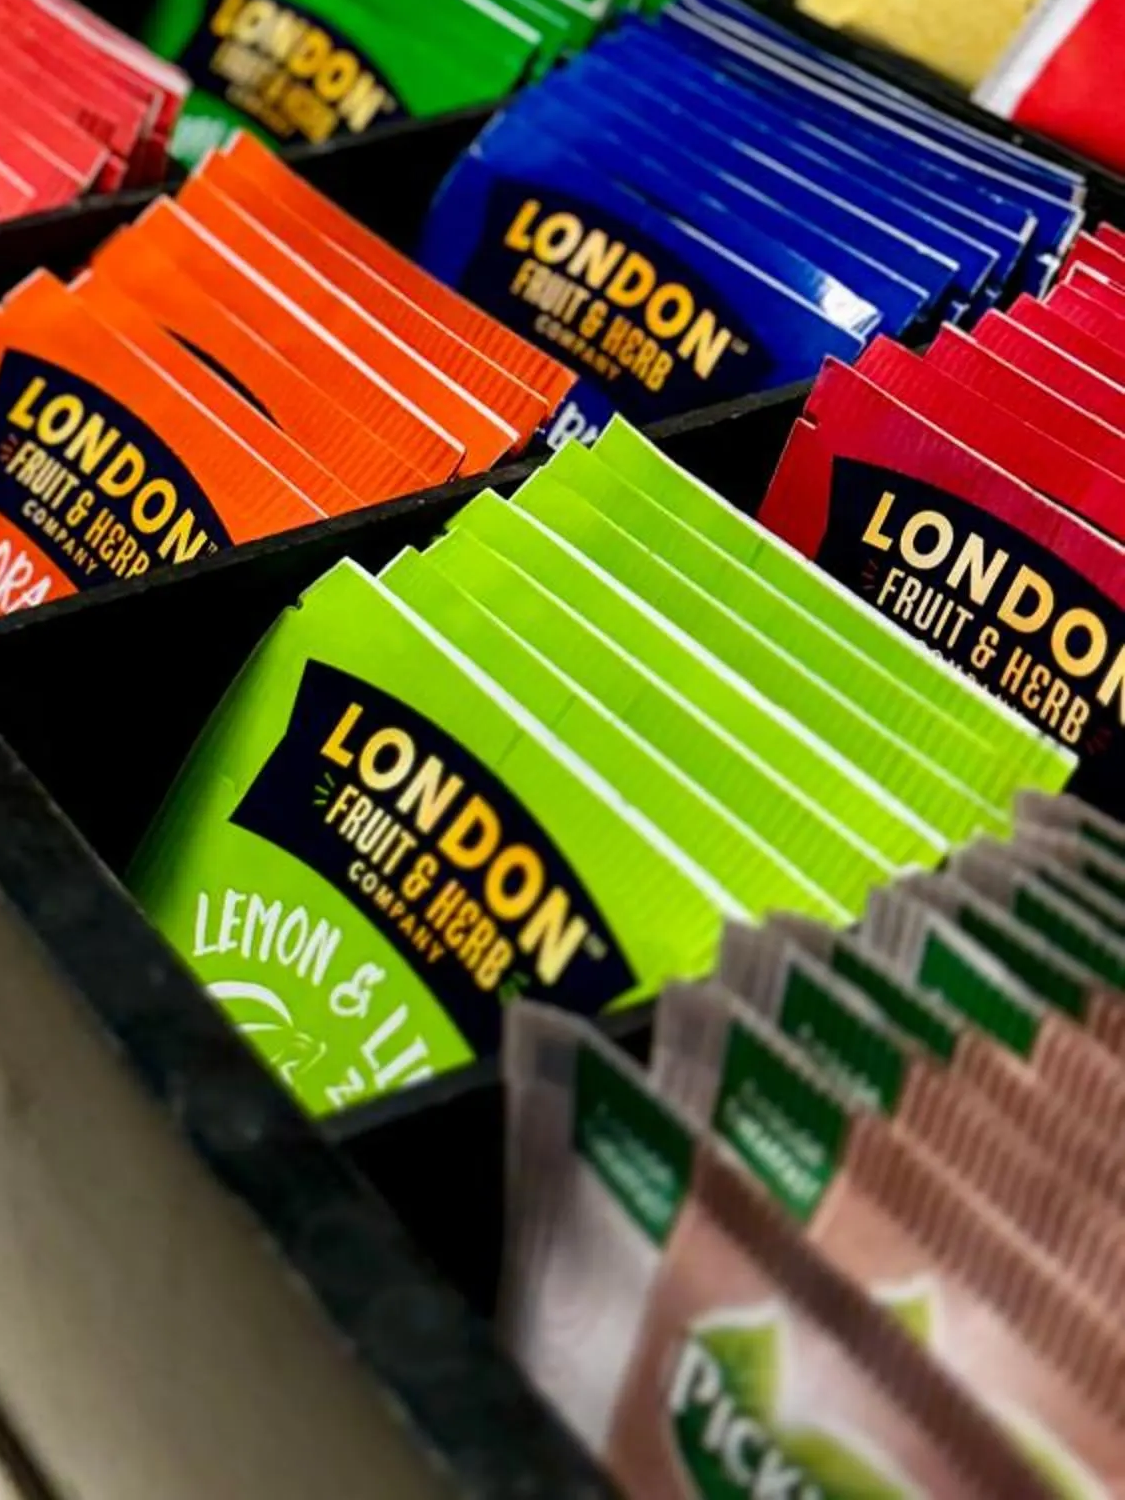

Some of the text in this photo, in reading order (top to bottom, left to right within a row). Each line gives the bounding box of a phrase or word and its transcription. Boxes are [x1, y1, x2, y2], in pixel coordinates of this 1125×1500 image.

[504, 198, 732, 380] LONDON
[509, 258, 674, 392] FRUIT & HERB
[5, 440, 82, 511] FRUIT
[65, 487, 96, 528] &
[7, 375, 208, 564] LONDON
[21, 499, 100, 577] COMPANY
[877, 566, 975, 649] FRUIT
[969, 625, 1001, 671] &
[998, 646, 1091, 745] HERB
[320, 701, 587, 987] LONDON
[325, 784, 515, 992] FRUIT & HERB
[347, 861, 448, 966] COMPANY
[192, 888, 342, 987] LEMON
[329, 959, 386, 1018] &
